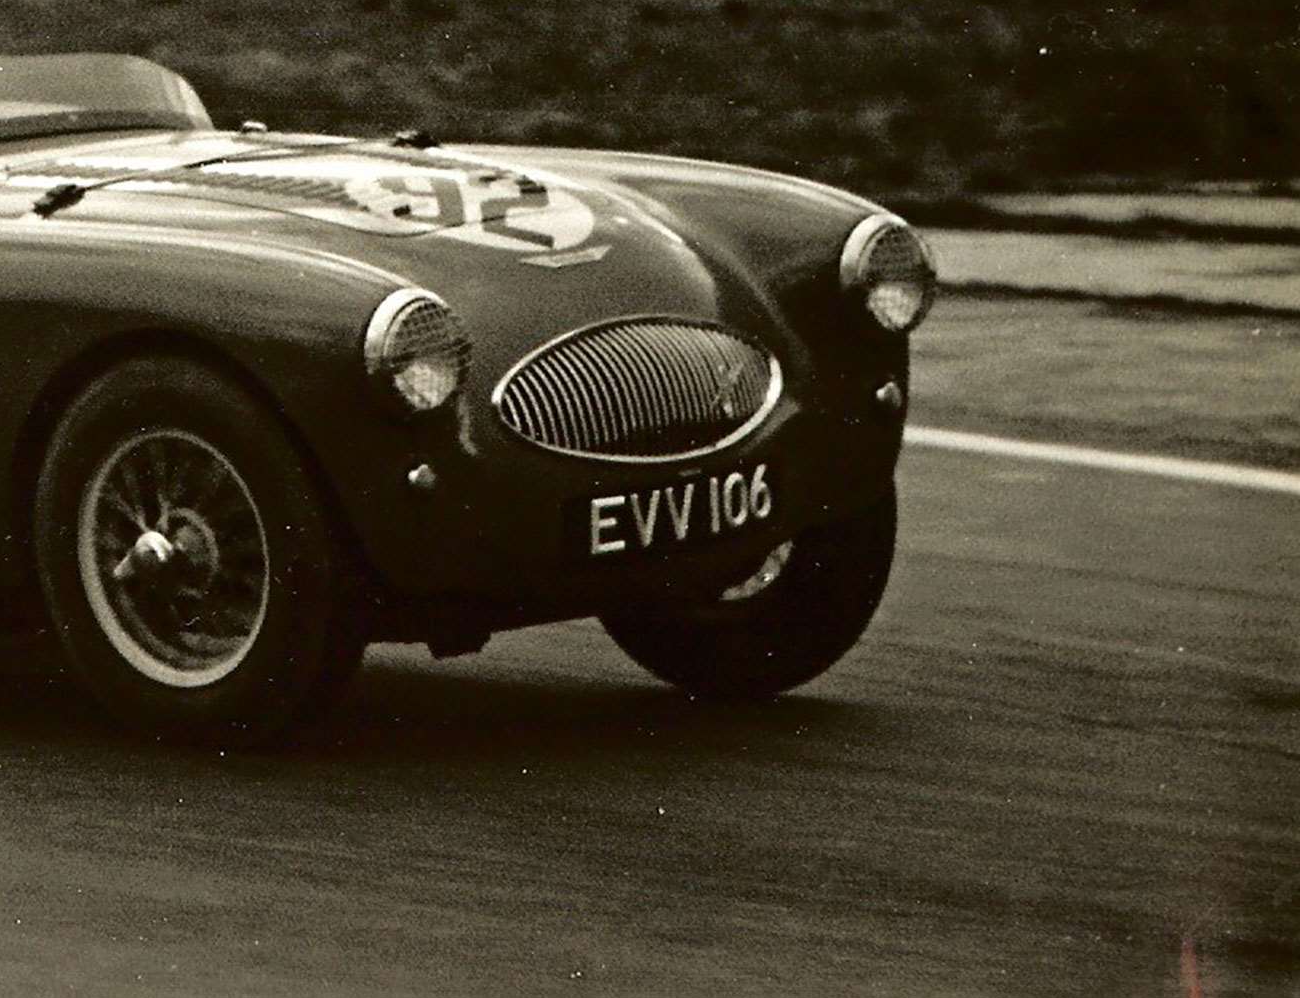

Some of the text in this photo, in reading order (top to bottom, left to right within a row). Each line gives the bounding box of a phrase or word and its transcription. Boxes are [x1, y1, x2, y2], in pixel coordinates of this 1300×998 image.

[377, 170, 555, 248] 92
[591, 464, 772, 554] EVV 106
